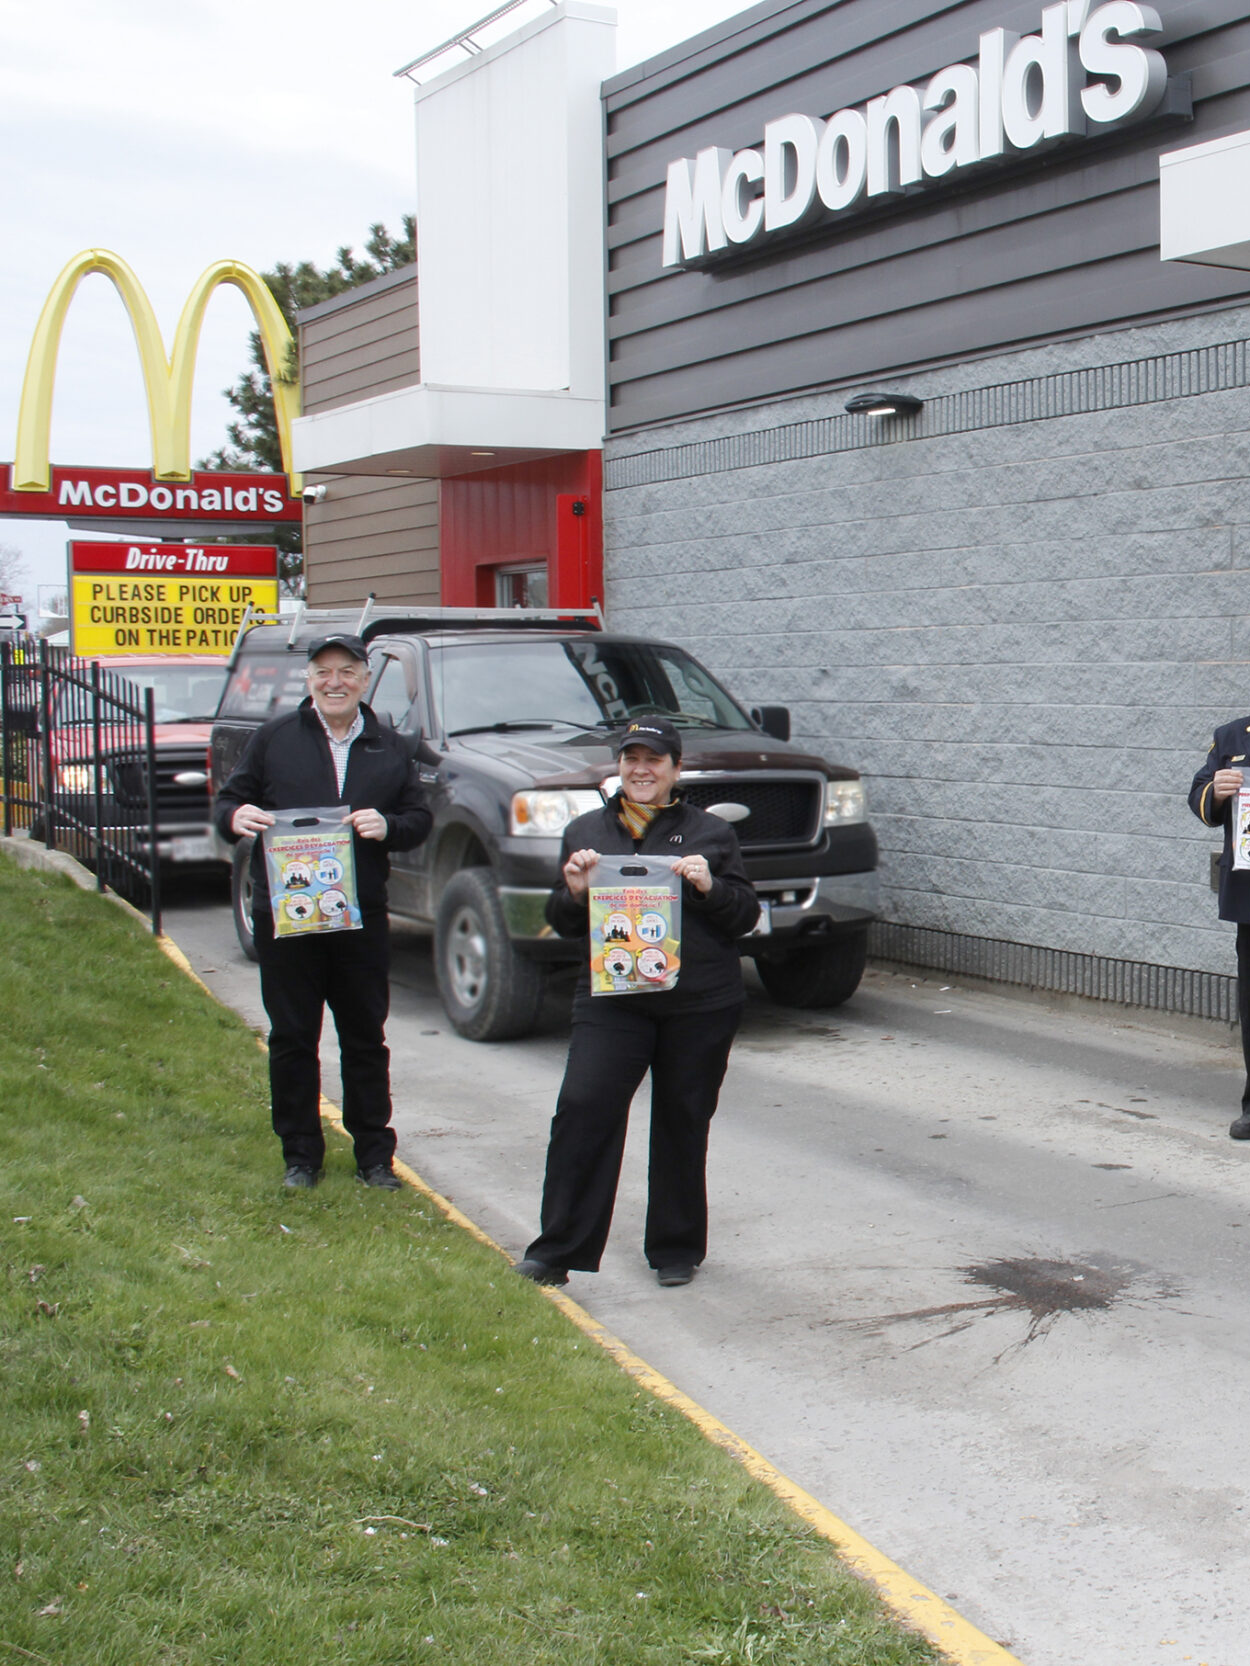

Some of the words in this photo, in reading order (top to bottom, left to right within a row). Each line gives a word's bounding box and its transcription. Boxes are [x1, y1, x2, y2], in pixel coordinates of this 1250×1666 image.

[661, 0, 1165, 270] McDonald's
[58, 480, 284, 513] McDonald's
[125, 547, 229, 572] Drive-Thru
[92, 583, 166, 601] PLEASE
[179, 585, 220, 602] PICK
[229, 586, 252, 603] UP
[90, 606, 184, 624] CURBSIDE
[115, 629, 140, 646] ON
[147, 629, 181, 647] THE
